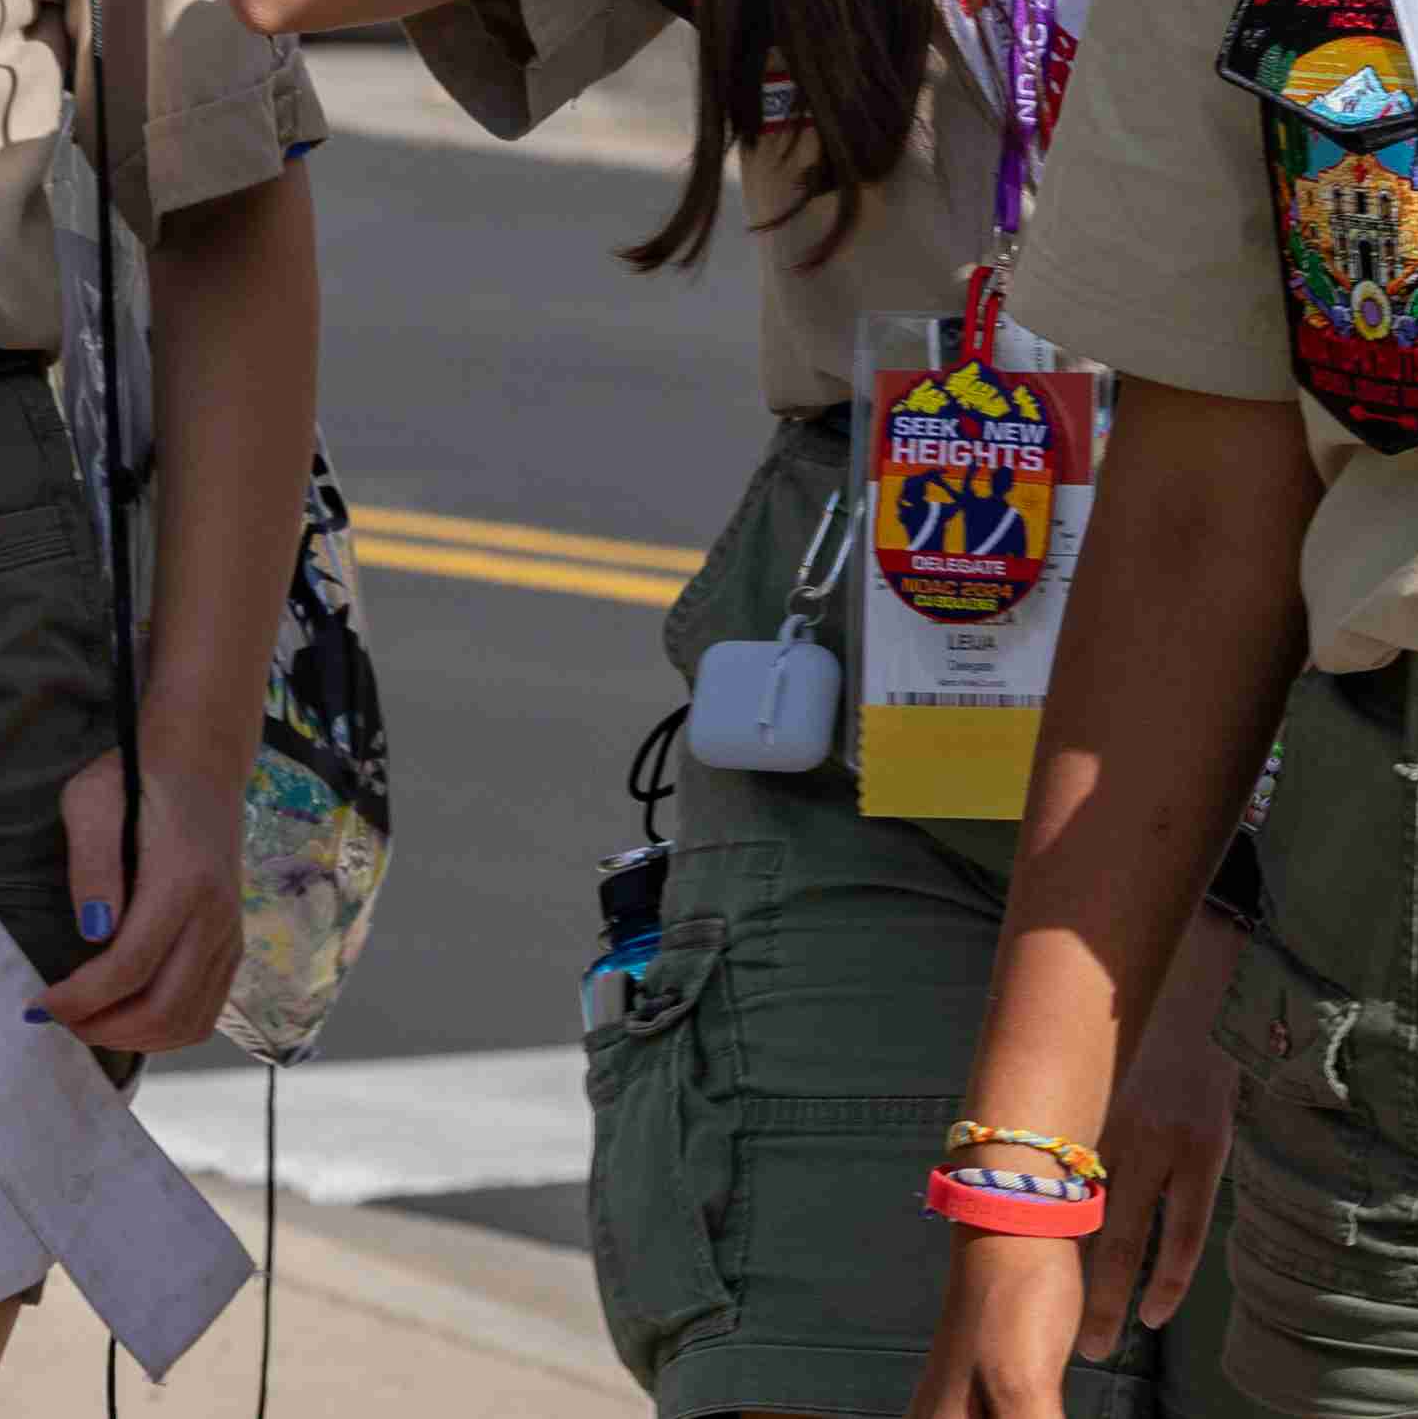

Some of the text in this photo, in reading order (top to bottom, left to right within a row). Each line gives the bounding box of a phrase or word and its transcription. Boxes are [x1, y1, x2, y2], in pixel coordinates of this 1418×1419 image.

[893, 416, 1047, 444] SEEK NEW
[891, 438, 1045, 472] HEIGHTS
[911, 555, 1007, 576] DELEGATE
